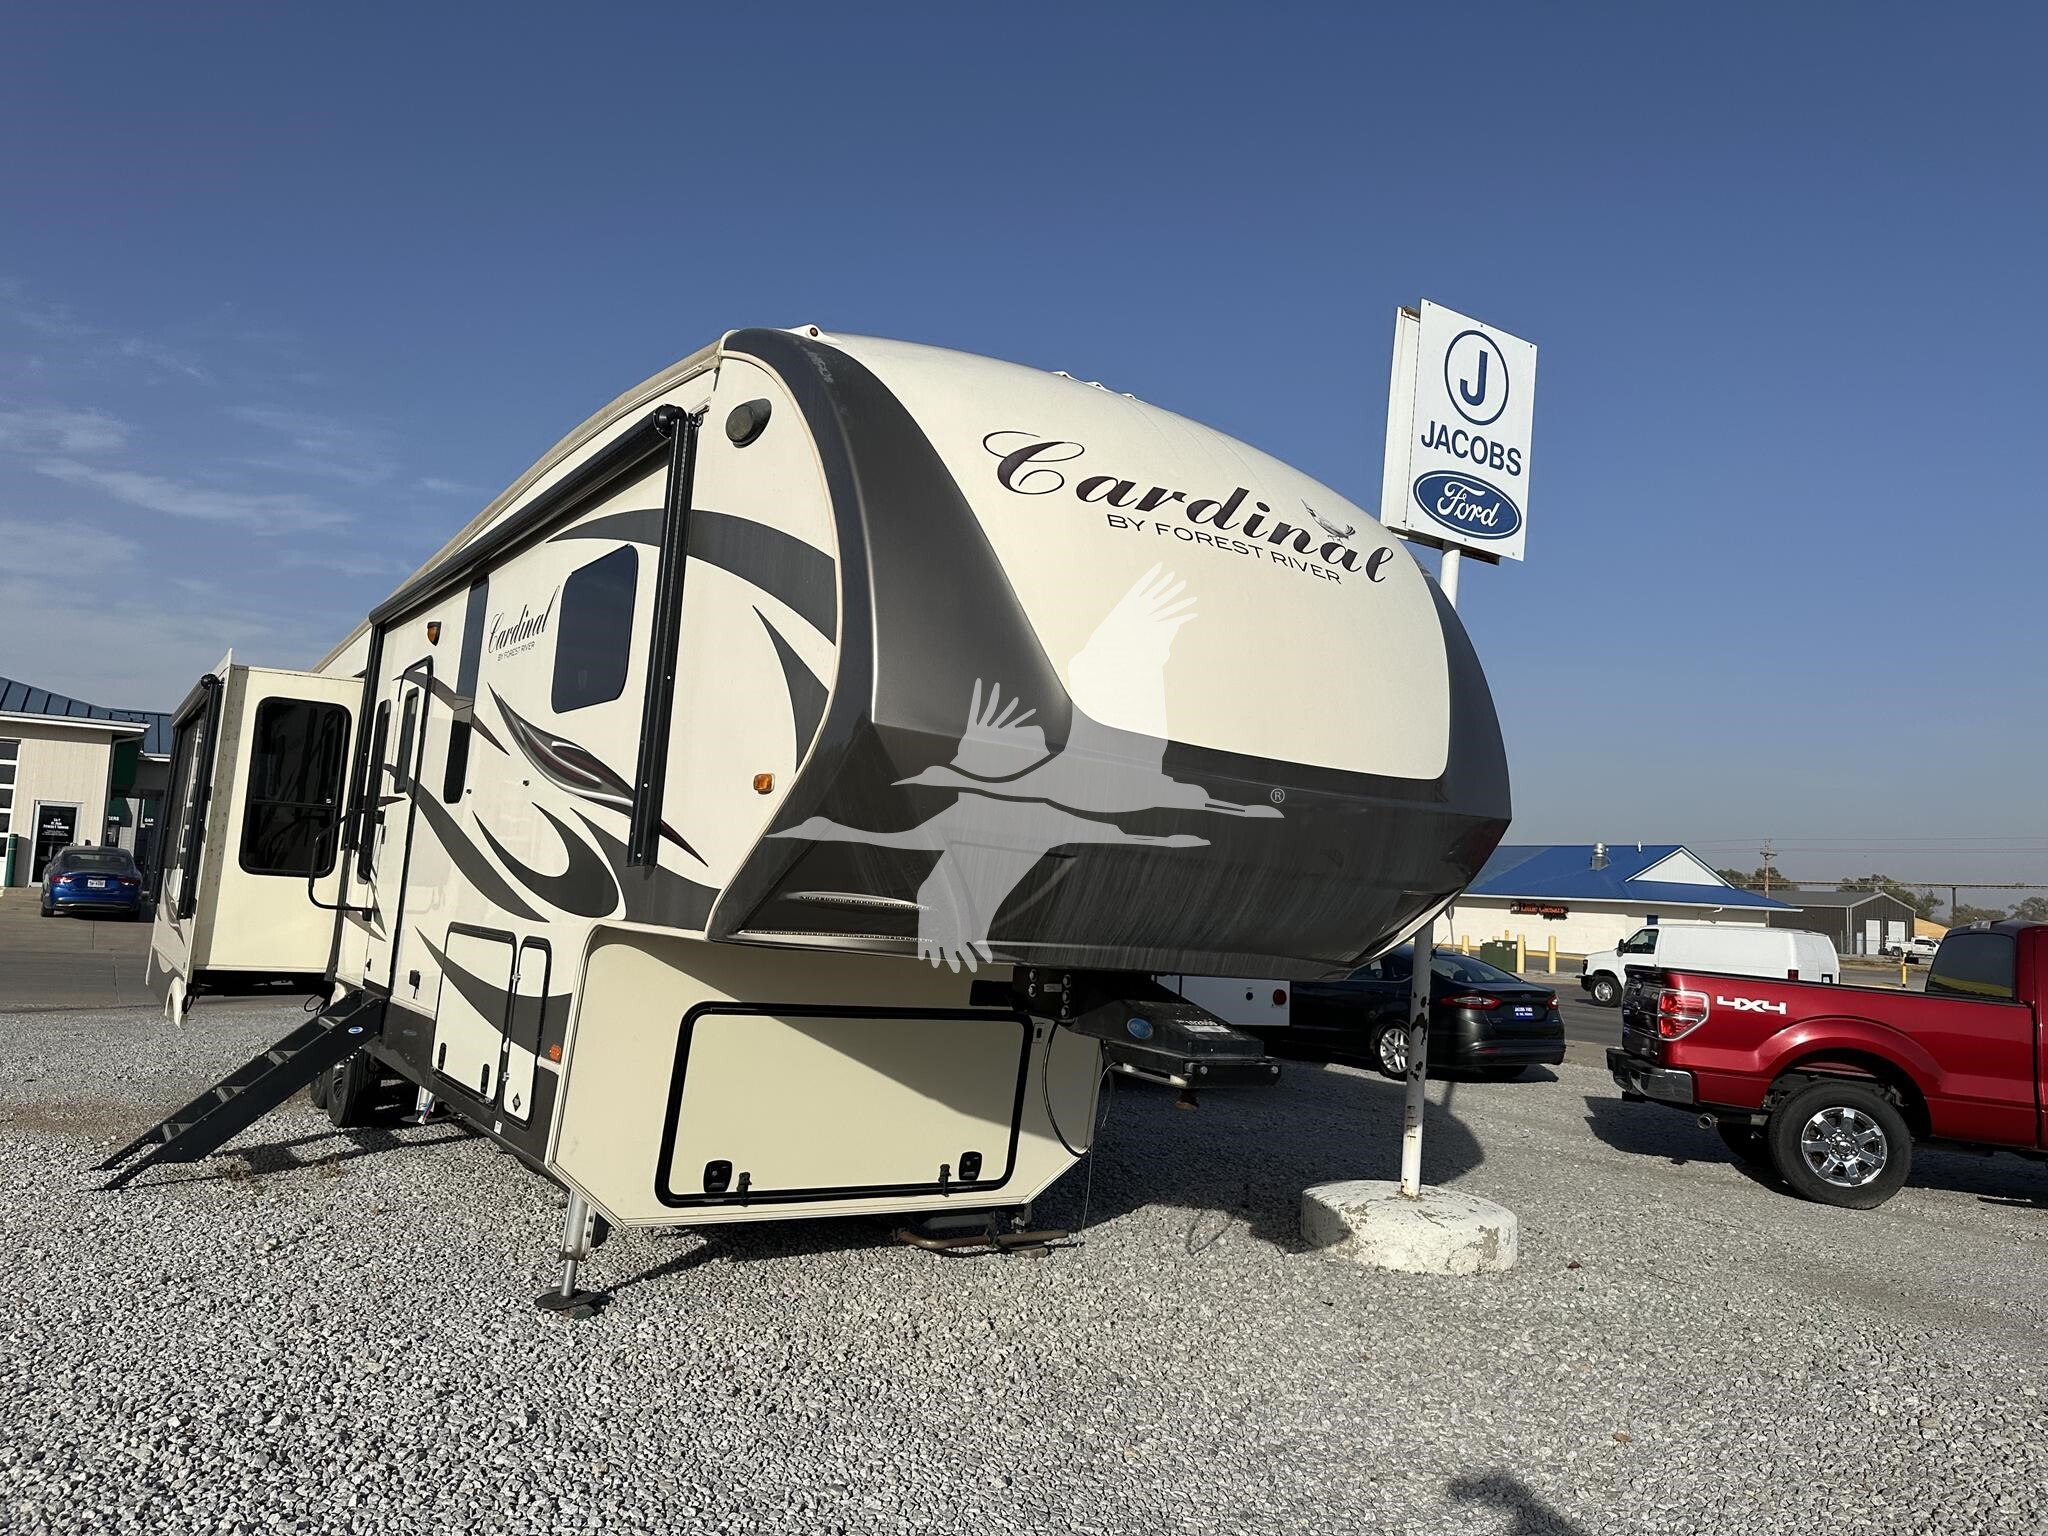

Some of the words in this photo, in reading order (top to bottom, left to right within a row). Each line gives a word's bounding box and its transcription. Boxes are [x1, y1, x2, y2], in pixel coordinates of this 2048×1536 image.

[1460, 350, 1488, 406] J
[1421, 420, 1522, 477] JACOBS
[983, 431, 1394, 583] Cardinal
[1436, 481, 1500, 527] Ford
[1107, 514, 1145, 531] BY
[1155, 523, 1263, 558] FOREST
[1270, 551, 1342, 584] RIVER
[488, 585, 560, 653] Cardinal
